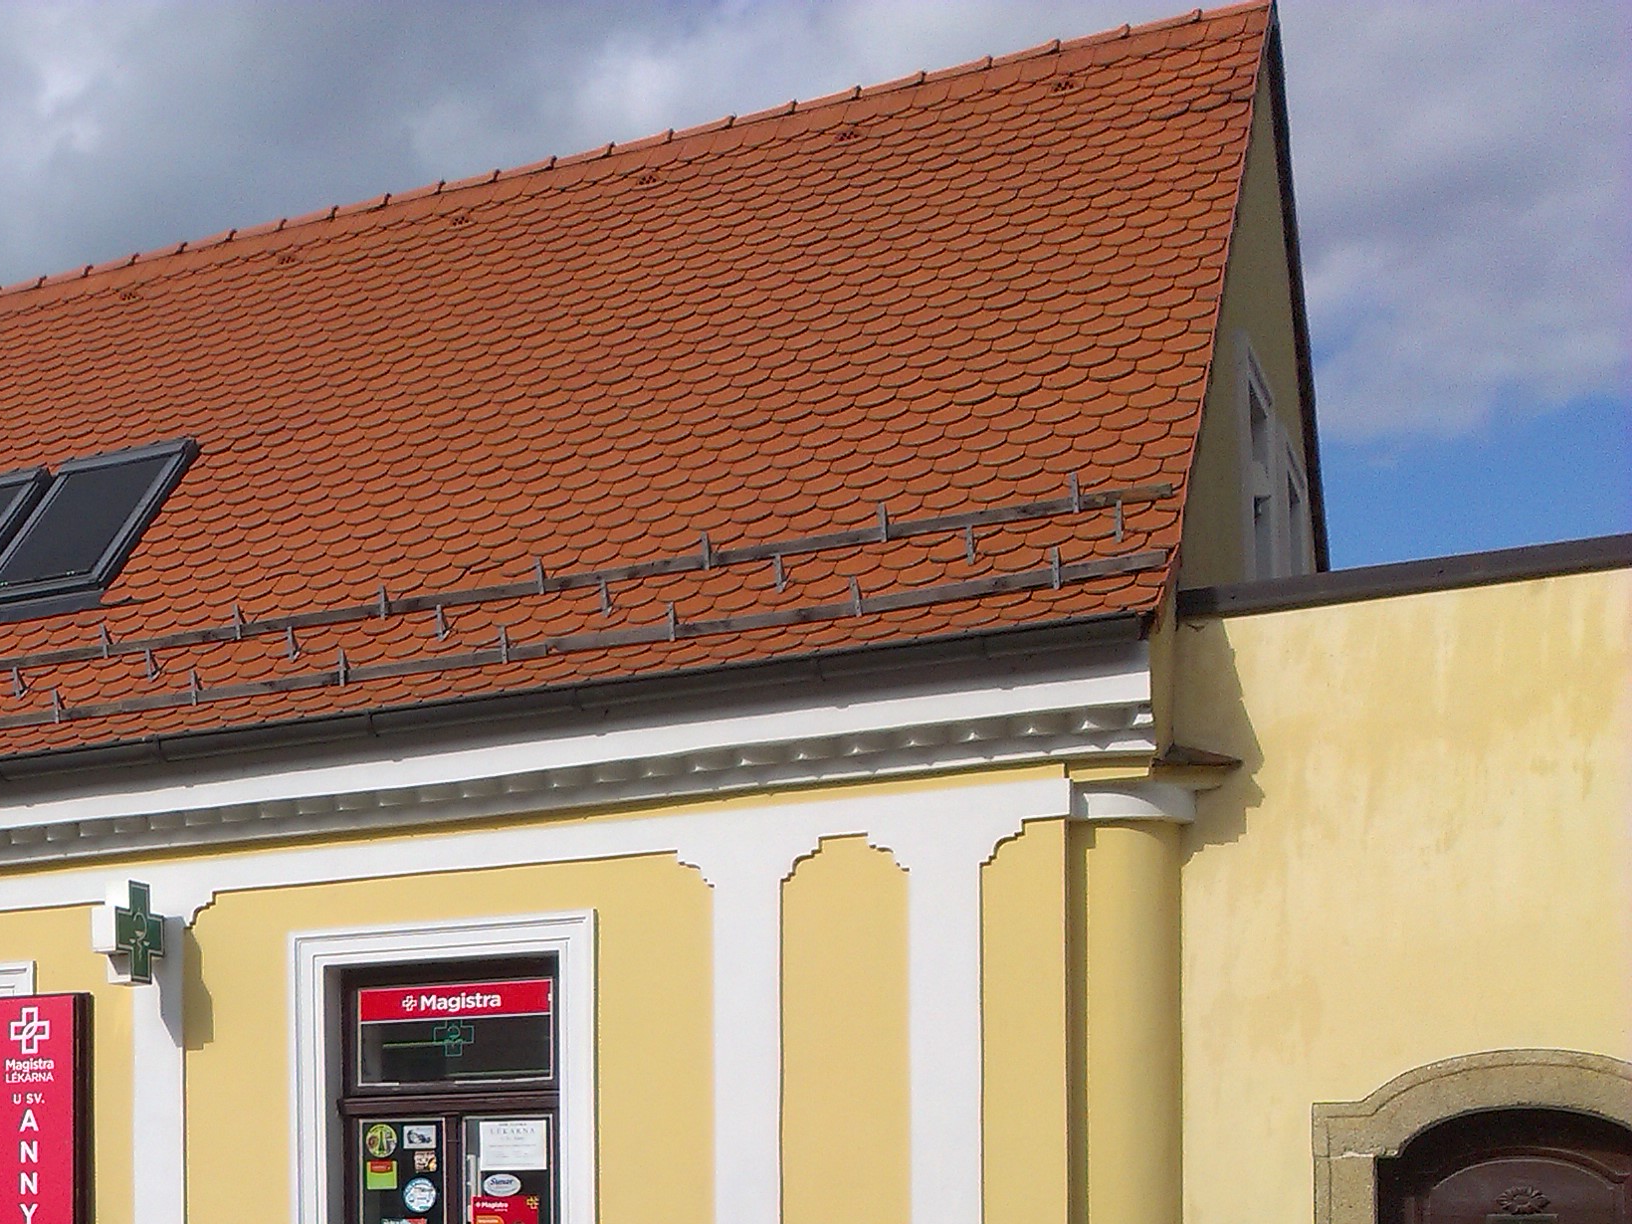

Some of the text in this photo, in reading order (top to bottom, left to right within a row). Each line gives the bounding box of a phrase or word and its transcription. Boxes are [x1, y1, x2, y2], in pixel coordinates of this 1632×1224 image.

[419, 992, 502, 1012] Magistra
[5, 1058, 55, 1073] Magistra
[5, 1071, 54, 1084] LÉKÁRNA
[13, 1092, 46, 1105] U SV.
